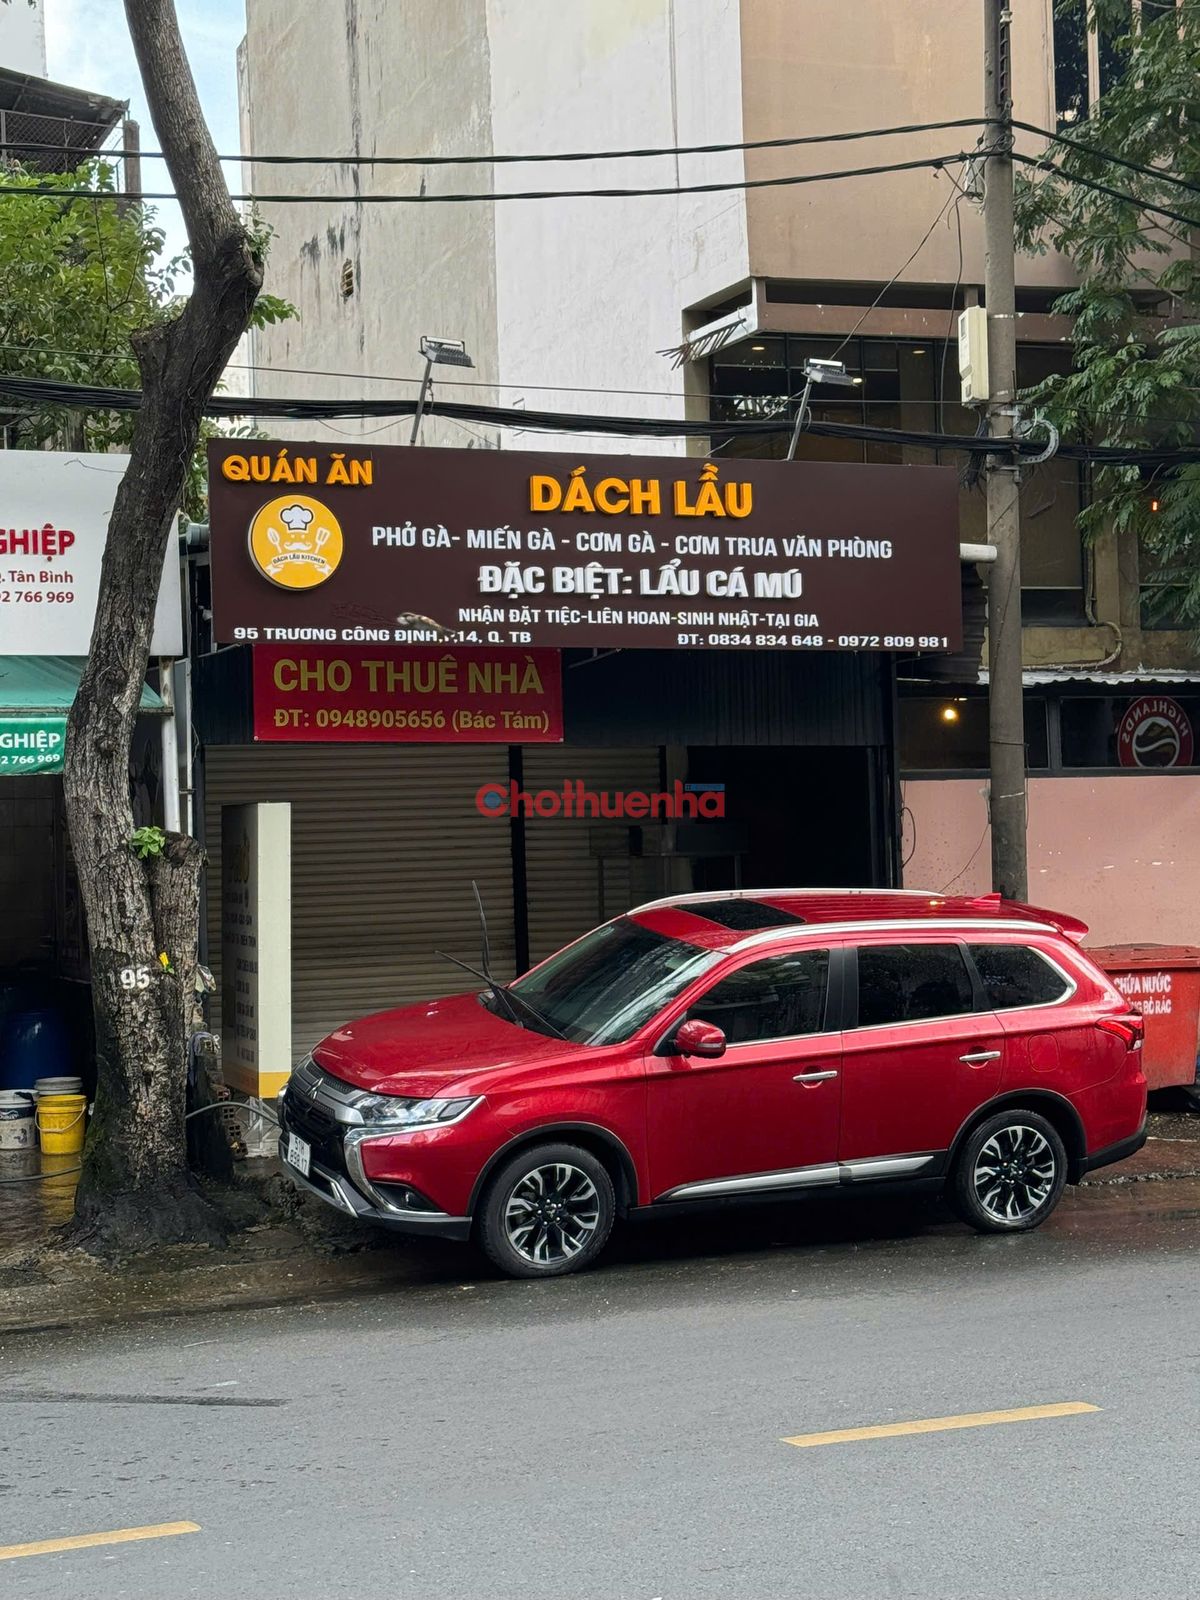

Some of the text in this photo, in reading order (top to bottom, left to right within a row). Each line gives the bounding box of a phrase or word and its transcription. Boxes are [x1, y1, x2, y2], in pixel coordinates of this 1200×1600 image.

[222, 448, 373, 485] QUÁN ĂN
[530, 463, 752, 518] DÁCH LẦU
[372, 521, 416, 547] PHỞ
[467, 525, 521, 550] MIẾN
[527, 528, 556, 550] GÀ
[576, 532, 622, 552] CƠM
[628, 530, 655, 553] GÀ
[675, 535, 720, 555] CƠM
[725, 537, 778, 557] TRƯA
[782, 535, 822, 557] VĂN
[828, 536, 892, 558] PHÒNG
[8, 570, 35, 583] Tân
[40, 571, 73, 583] Bình
[477, 558, 802, 599] ĐẶC BIỆT: LẨU CÁ MÚ
[15, 591, 43, 603] 766
[46, 592, 74, 603] 969
[459, 605, 505, 625] NHẬN
[509, 606, 541, 625] ĐẶT
[794, 613, 819, 627] GIA
[234, 628, 258, 639] 95
[263, 627, 336, 640] TRƯƠNG
[342, 626, 390, 641] CÔNG
[488, 631, 504, 643] Q.
[509, 631, 532, 643] TB
[678, 633, 704, 645] ĐT:
[708, 634, 752, 646] 0834
[755, 635, 788, 646] 834
[791, 635, 823, 647] 648
[838, 635, 879, 647] 0972
[883, 636, 915, 647] 809
[918, 636, 948, 648] 981
[274, 654, 545, 694] CHO THUÊ NHÀ
[273, 709, 549, 733] ĐT: 0948905656 (Bác Tám)
[0, 730, 61, 752] GHIỆP
[11, 756, 35, 764] 766
[37, 754, 60, 763] 969
[120, 966, 150, 990] 95
[1155, 995, 1172, 1015] RÁC
